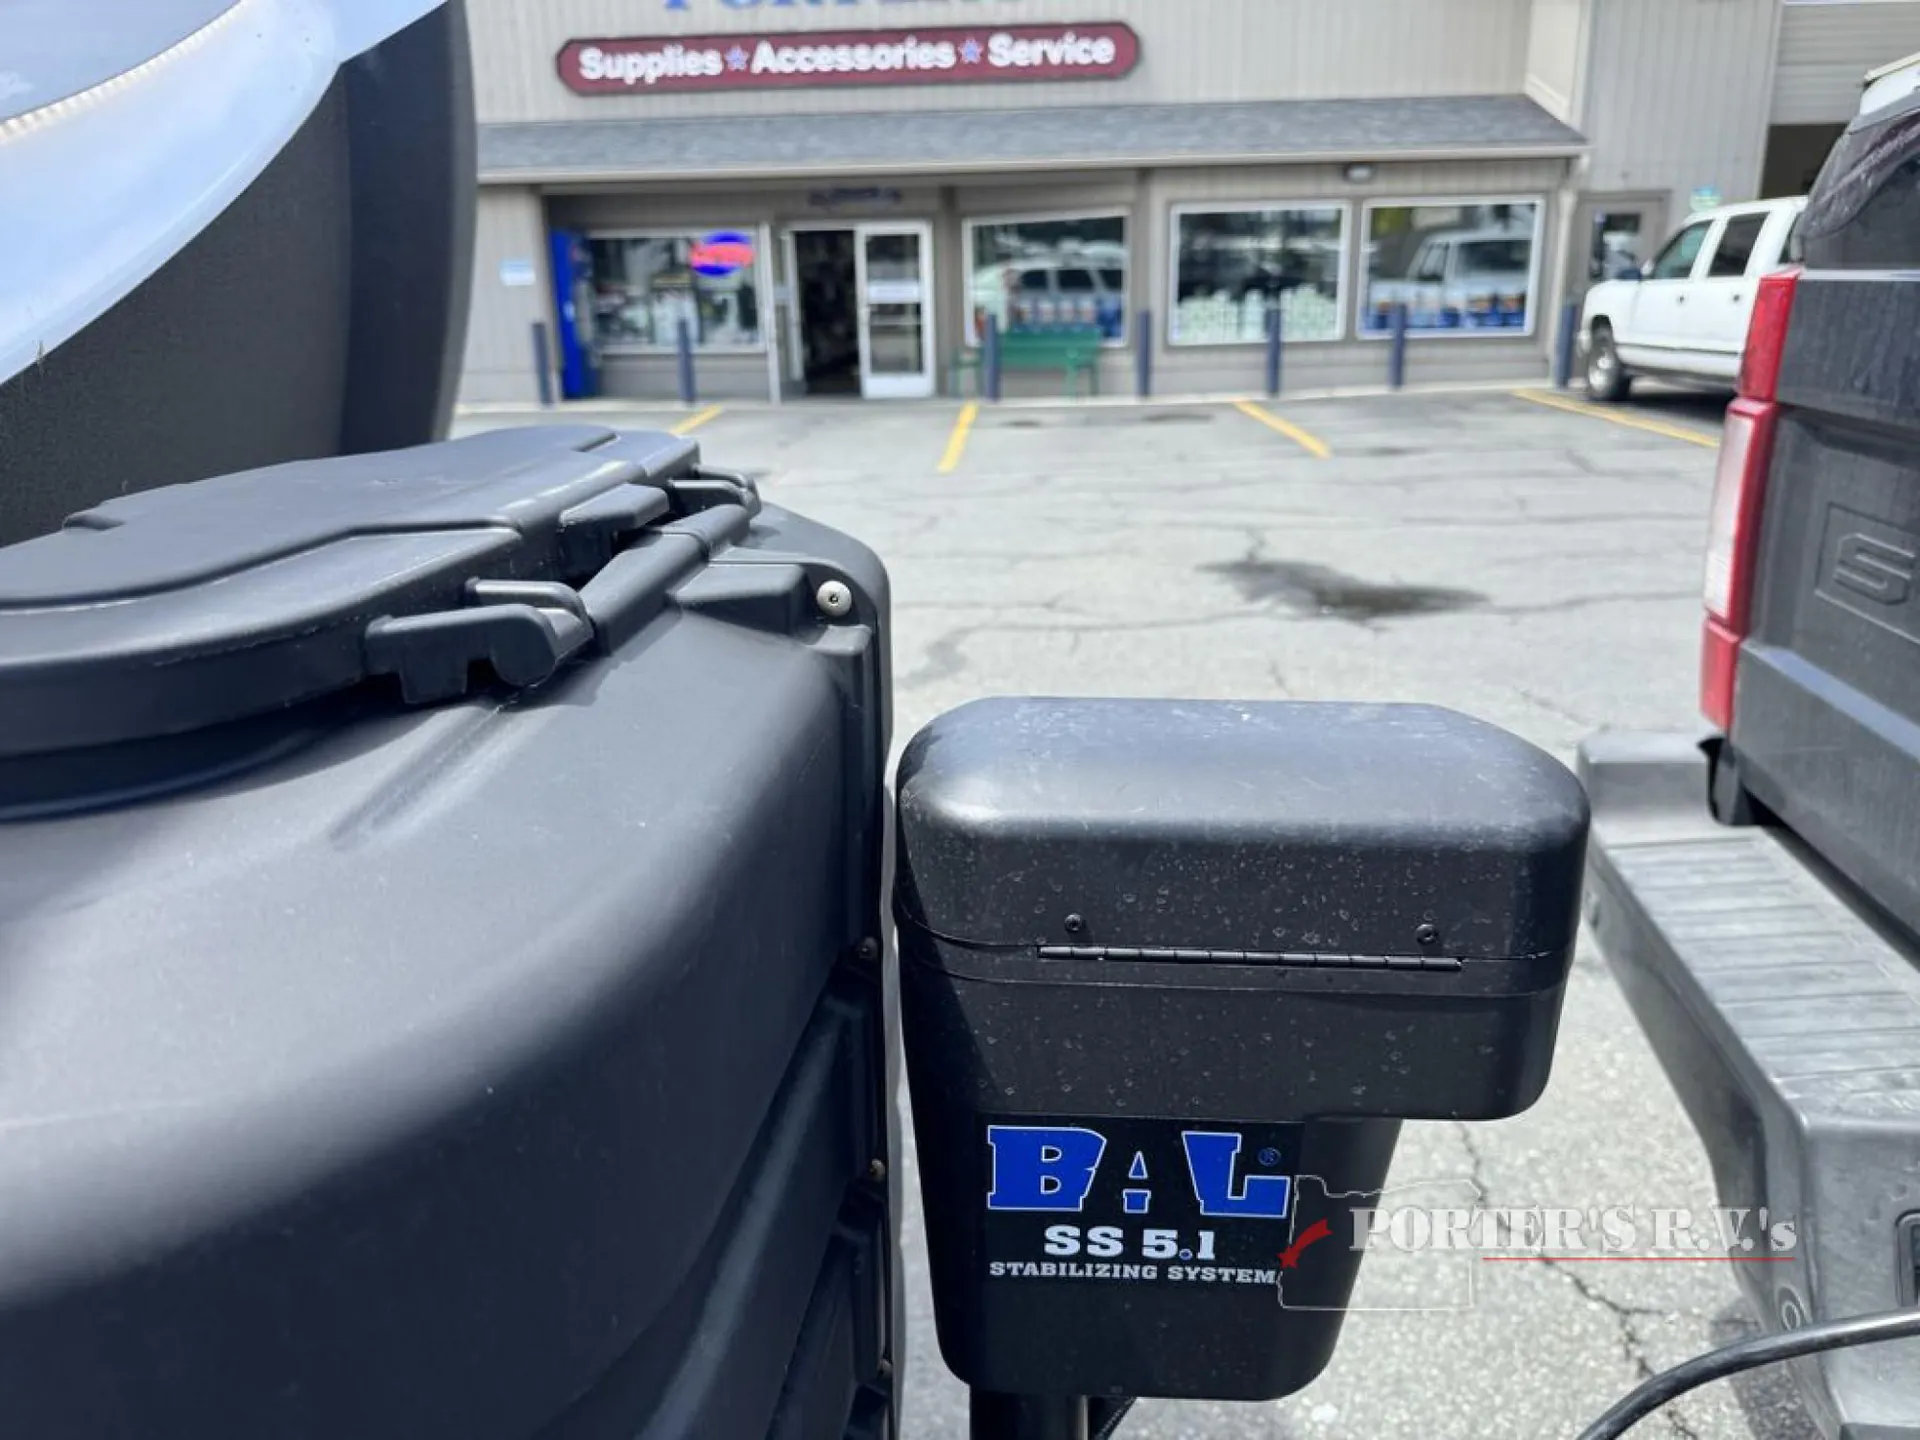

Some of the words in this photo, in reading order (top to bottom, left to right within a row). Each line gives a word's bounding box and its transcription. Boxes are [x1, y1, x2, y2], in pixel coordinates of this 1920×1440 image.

[579, 45, 724, 85] Supplies
[751, 37, 956, 74] Accessories
[987, 31, 1116, 67] Service
[1044, 1224, 1124, 1257] SS
[1142, 1228, 1216, 1261] 5.1
[989, 1261, 1158, 1280] STABILIZING
[1167, 1265, 1278, 1286] SYSTEM
